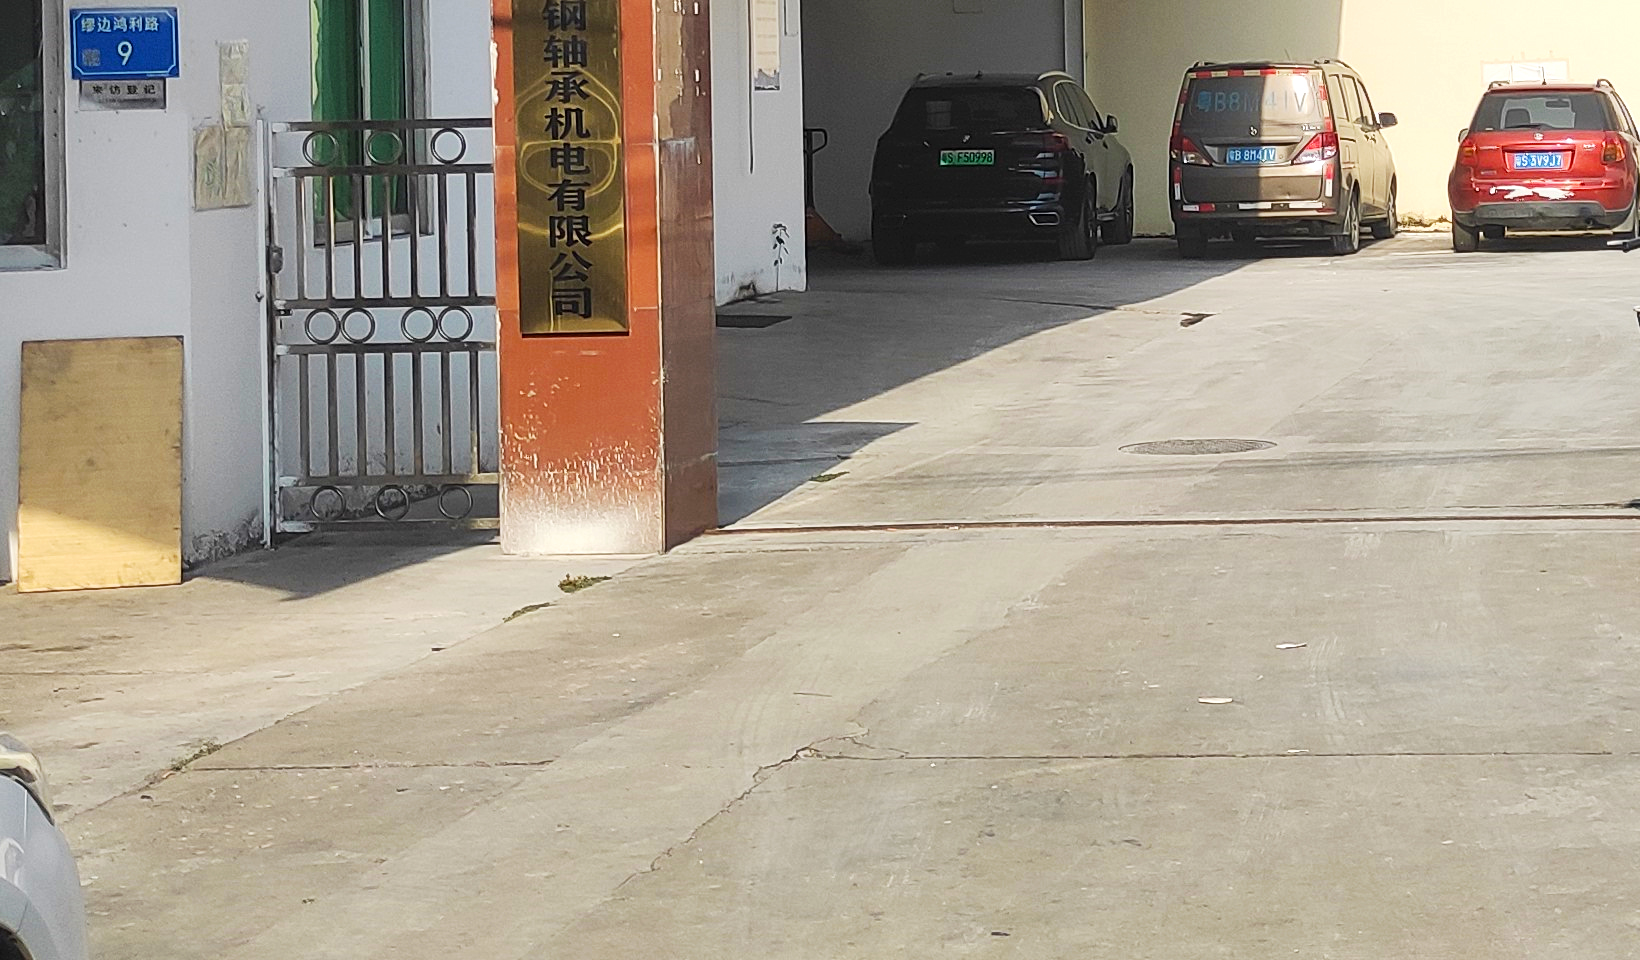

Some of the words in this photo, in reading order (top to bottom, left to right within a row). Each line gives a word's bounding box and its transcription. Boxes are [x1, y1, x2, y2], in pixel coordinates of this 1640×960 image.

[81, 16, 160, 33] 缪边鸿利路
[117, 41, 133, 66] 9
